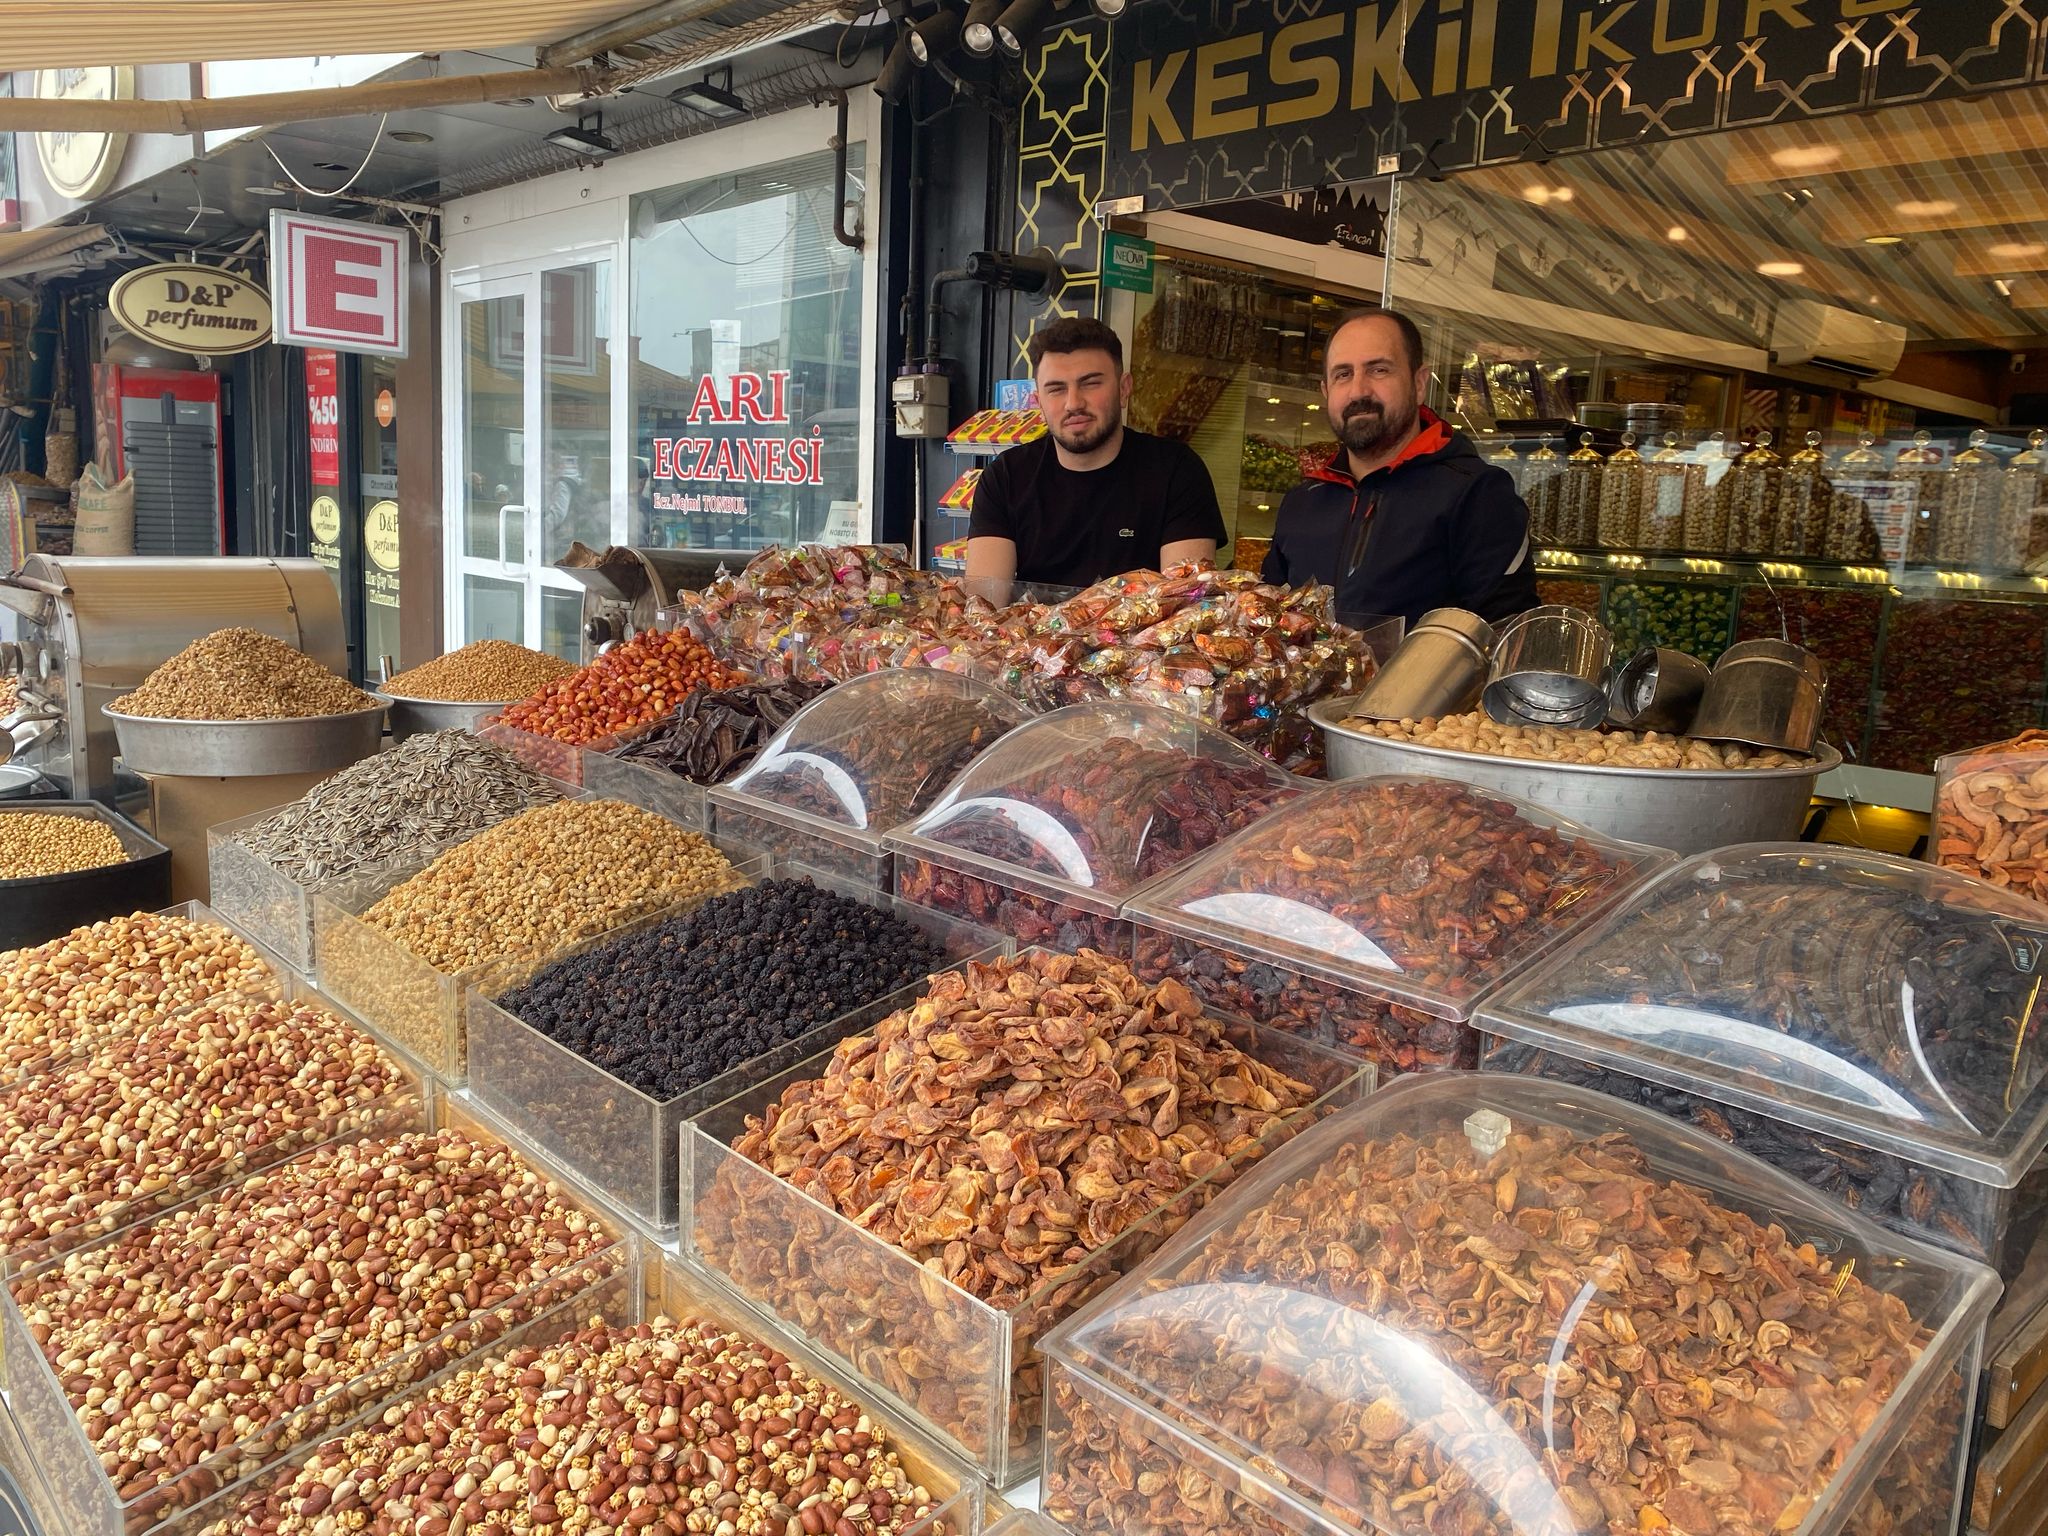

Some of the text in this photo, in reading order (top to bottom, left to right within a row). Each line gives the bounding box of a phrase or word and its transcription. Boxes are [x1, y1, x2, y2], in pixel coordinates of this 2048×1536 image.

[304, 235, 384, 336] E
[144, 306, 258, 332] perfumum
[309, 395, 338, 425] %50
[687, 369, 791, 426] ARI
[653, 424, 825, 485] ECZANESİ
[320, 504, 333, 518] D&P
[702, 495, 747, 514] TONBUL
